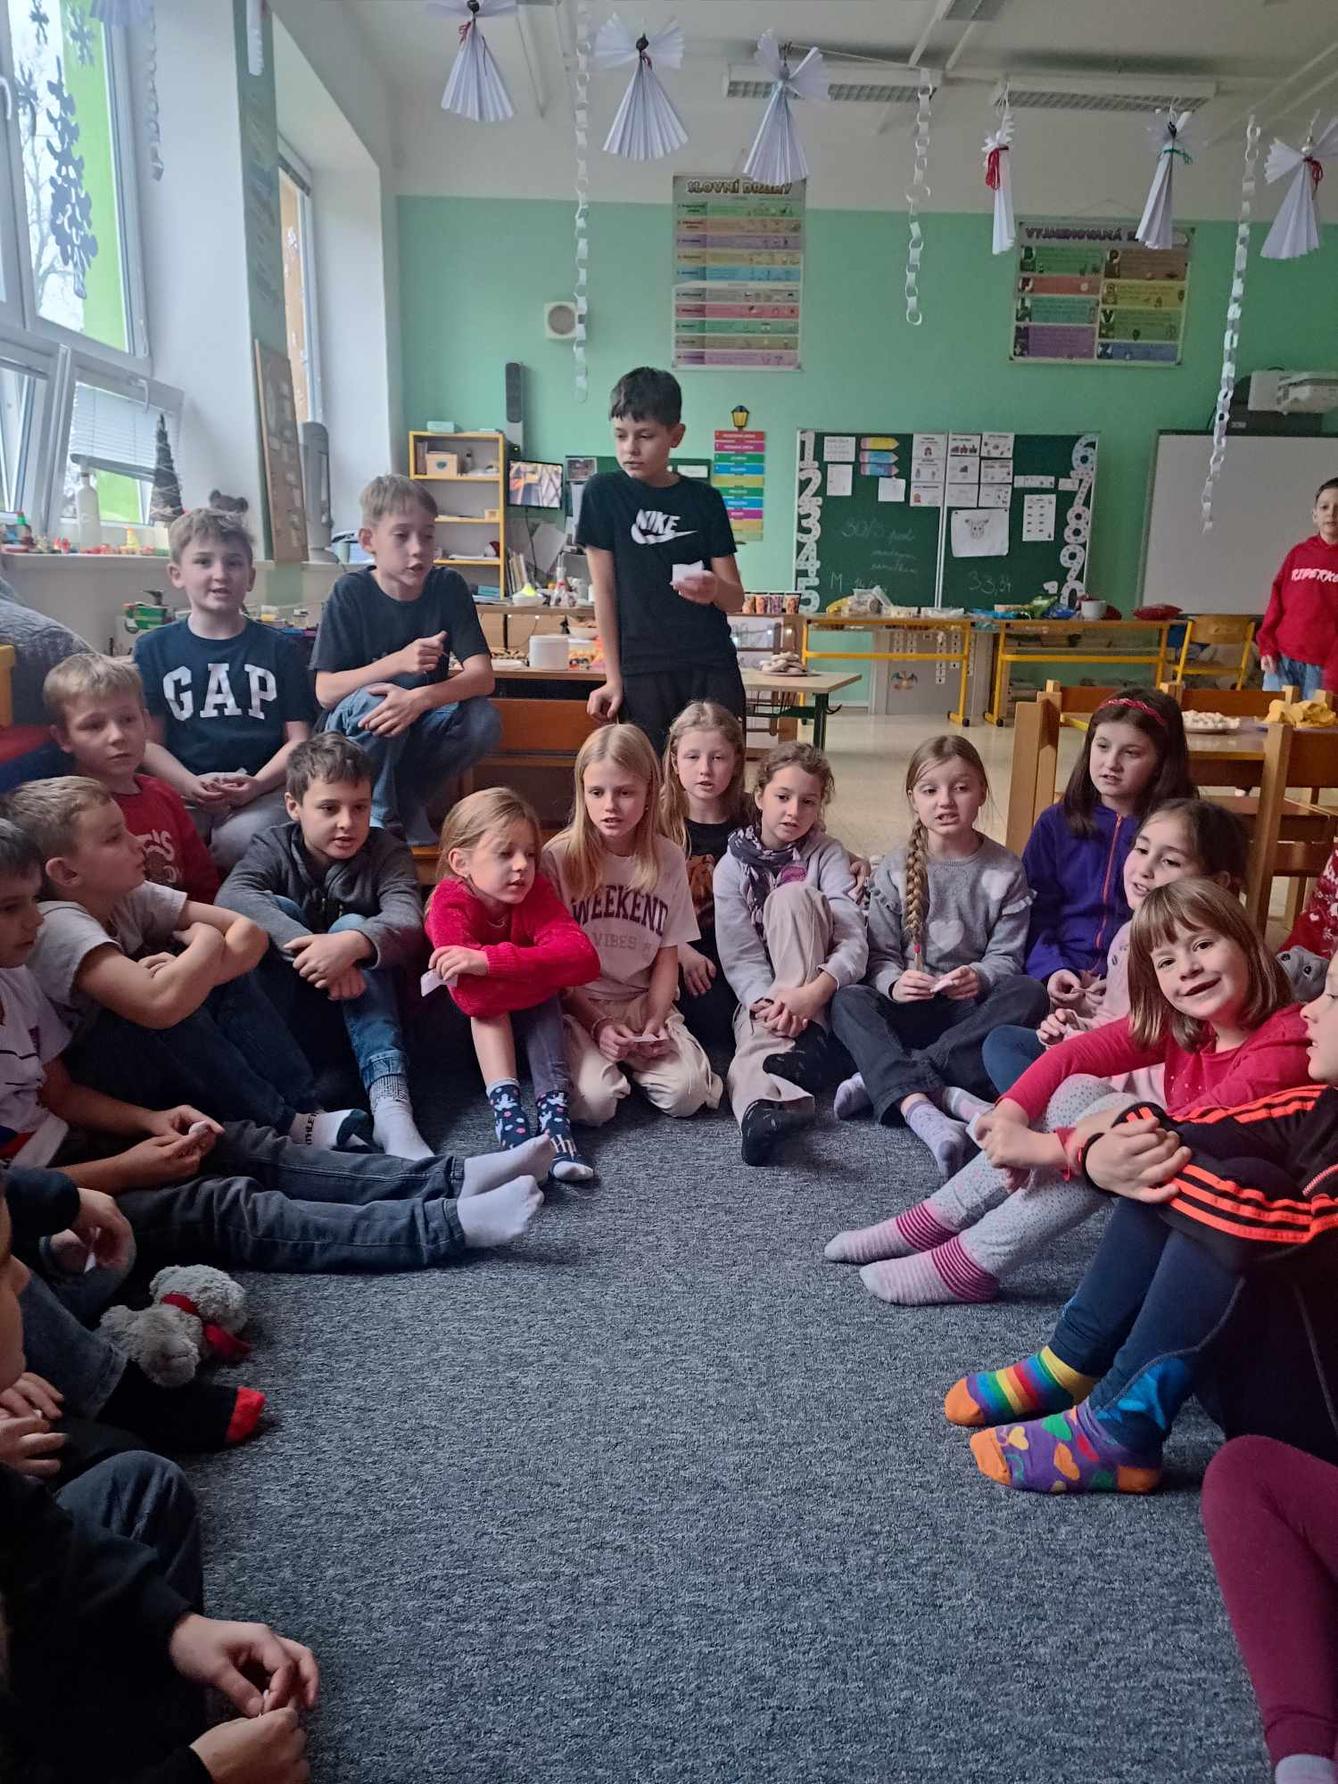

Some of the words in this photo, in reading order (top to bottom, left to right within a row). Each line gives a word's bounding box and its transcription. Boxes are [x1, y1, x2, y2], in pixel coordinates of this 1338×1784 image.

[687, 178, 740, 194] SLOVNÍ
[798, 469, 822, 505] 2
[635, 508, 681, 535] NIKE
[797, 503, 821, 543] 3
[796, 541, 820, 578] 4
[163, 662, 278, 721] GAP
[571, 884, 669, 937] WEEKEND
